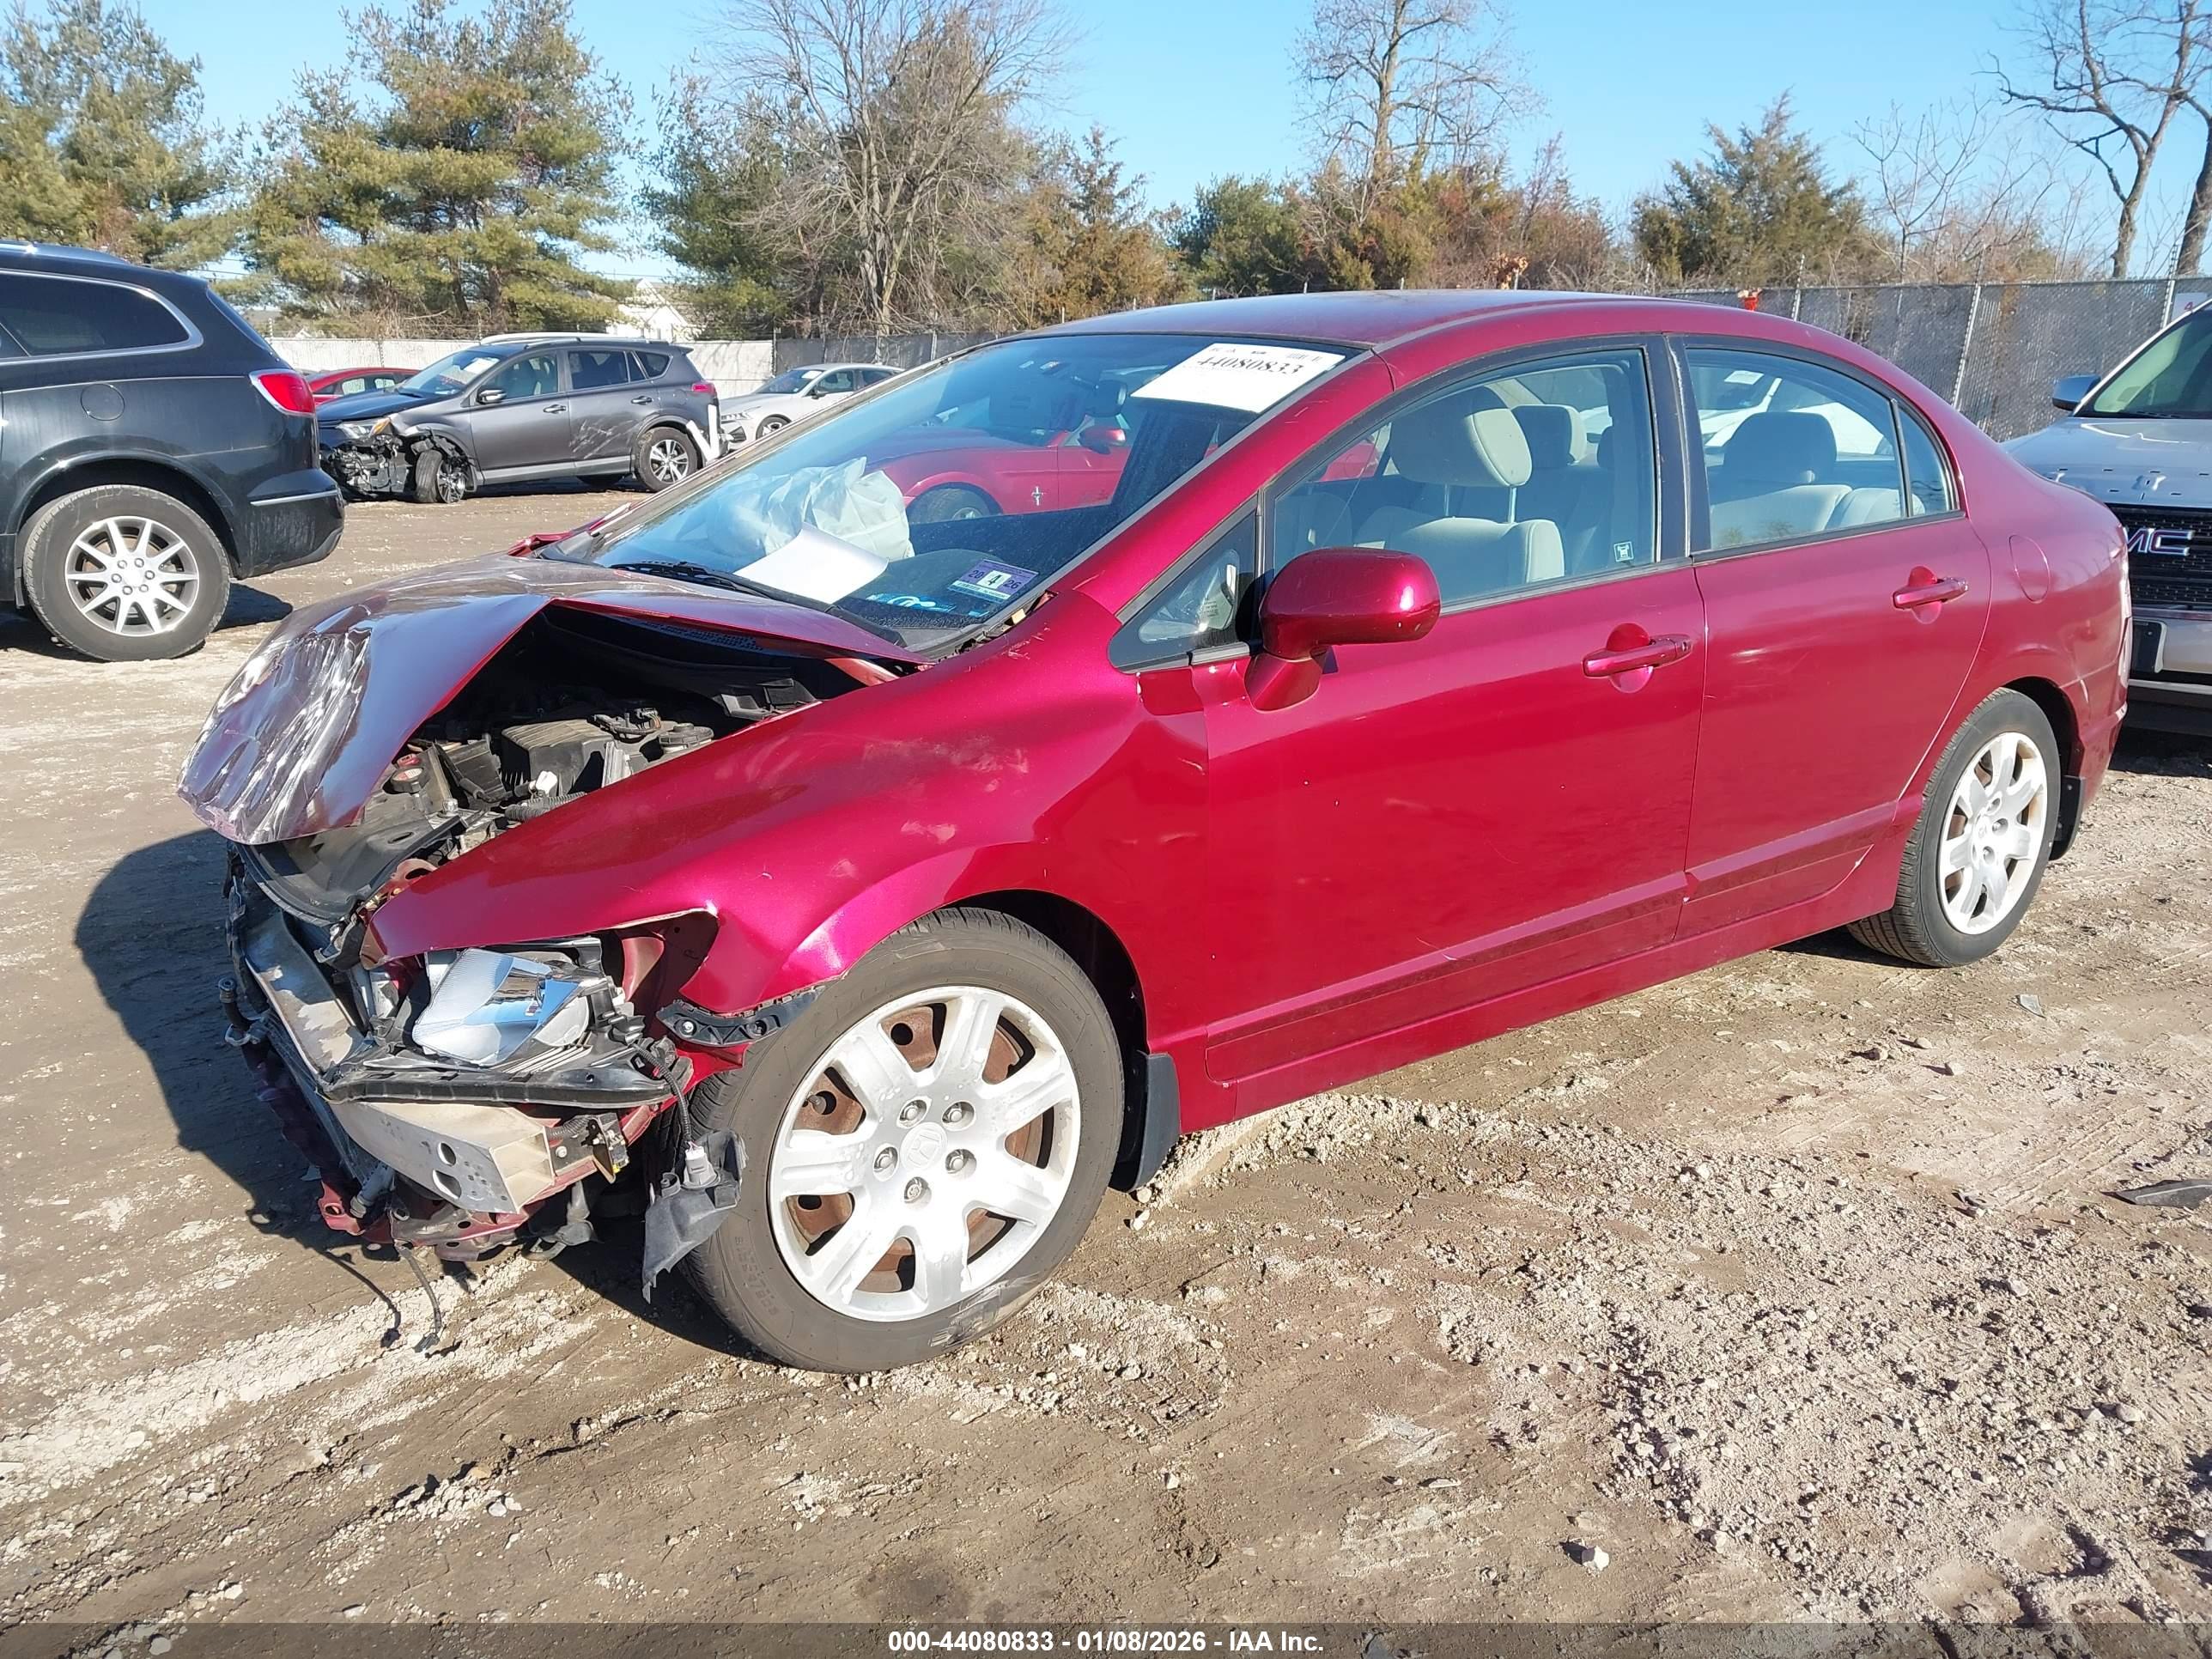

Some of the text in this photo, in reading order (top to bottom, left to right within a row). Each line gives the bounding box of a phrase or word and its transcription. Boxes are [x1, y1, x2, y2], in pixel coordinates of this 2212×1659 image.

[1197, 356, 1304, 374] 44080833
[2124, 526, 2195, 556] MC
[968, 569, 1022, 589] 20 4 26
